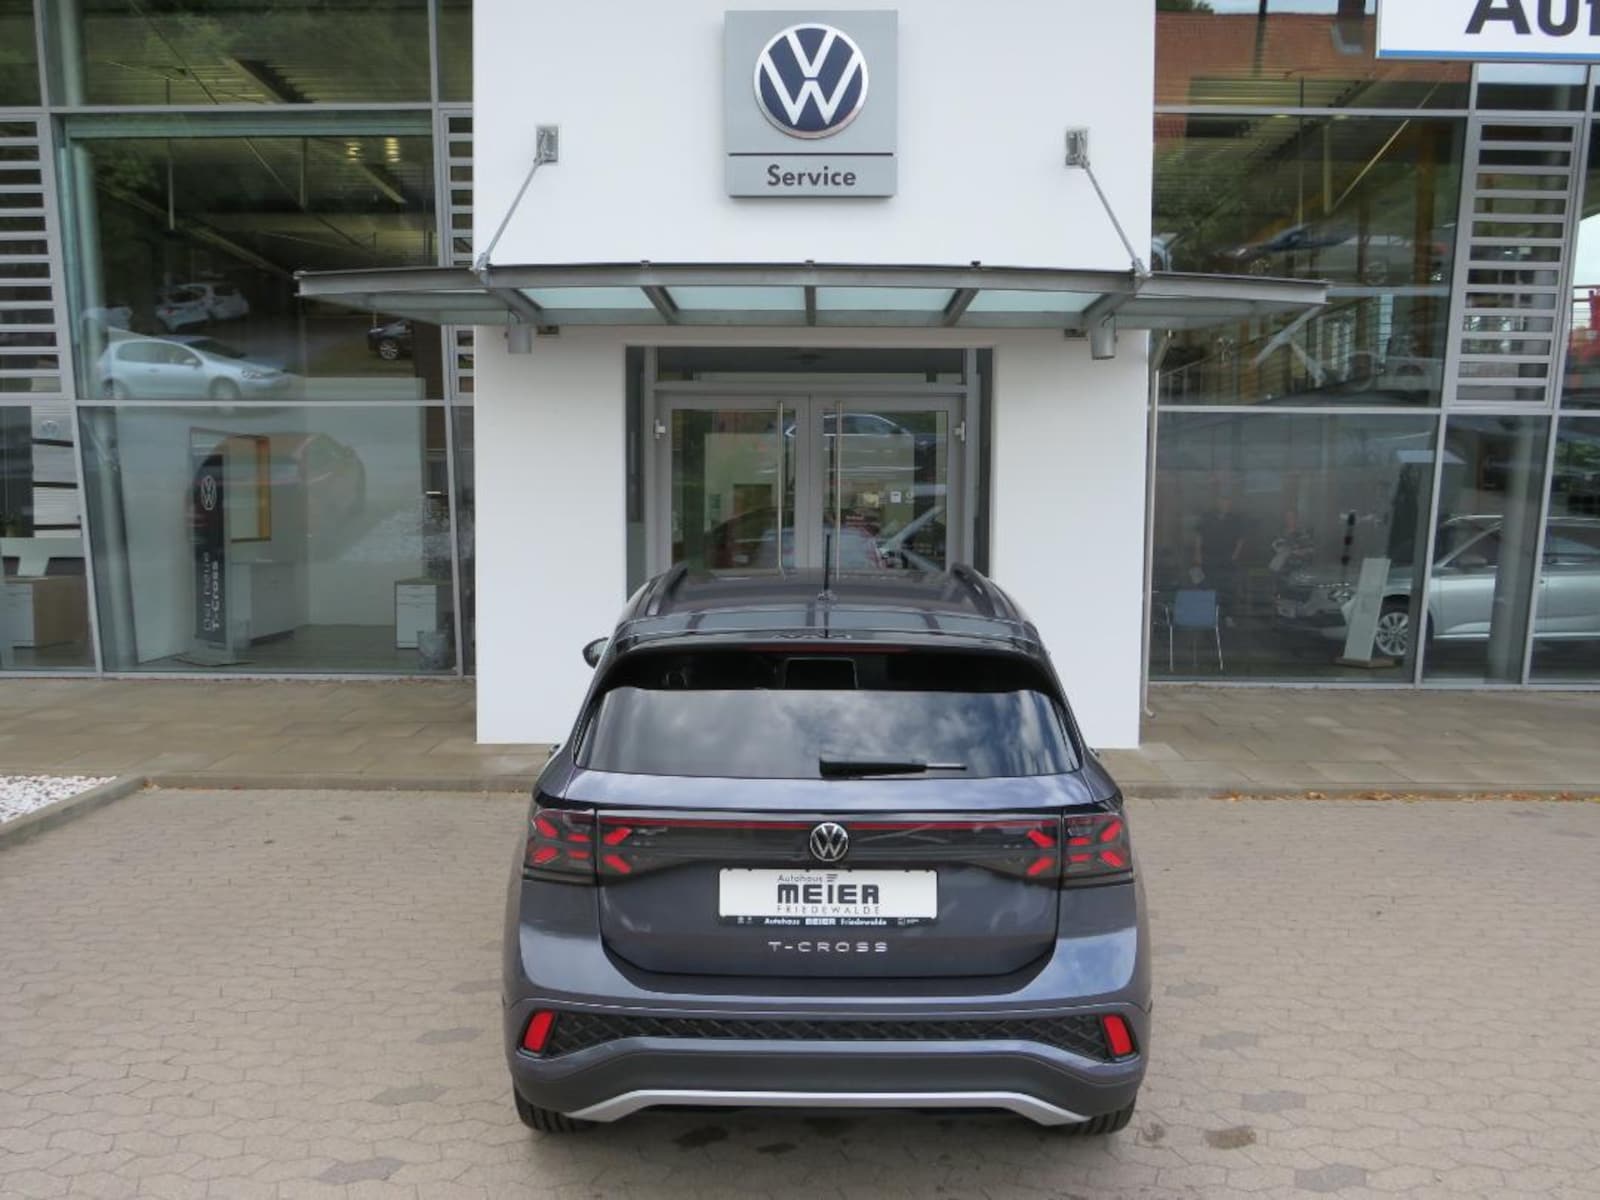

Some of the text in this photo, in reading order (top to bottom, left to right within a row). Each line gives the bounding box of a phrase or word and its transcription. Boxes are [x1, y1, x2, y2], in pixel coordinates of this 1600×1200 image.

[754, 23, 868, 139] VW
[767, 164, 856, 186] Service
[777, 874, 823, 882] Autohaus
[777, 884, 879, 904] MEIER
[777, 906, 880, 914] FRIEDEWALDE
[768, 941, 888, 952] T-CROSS
